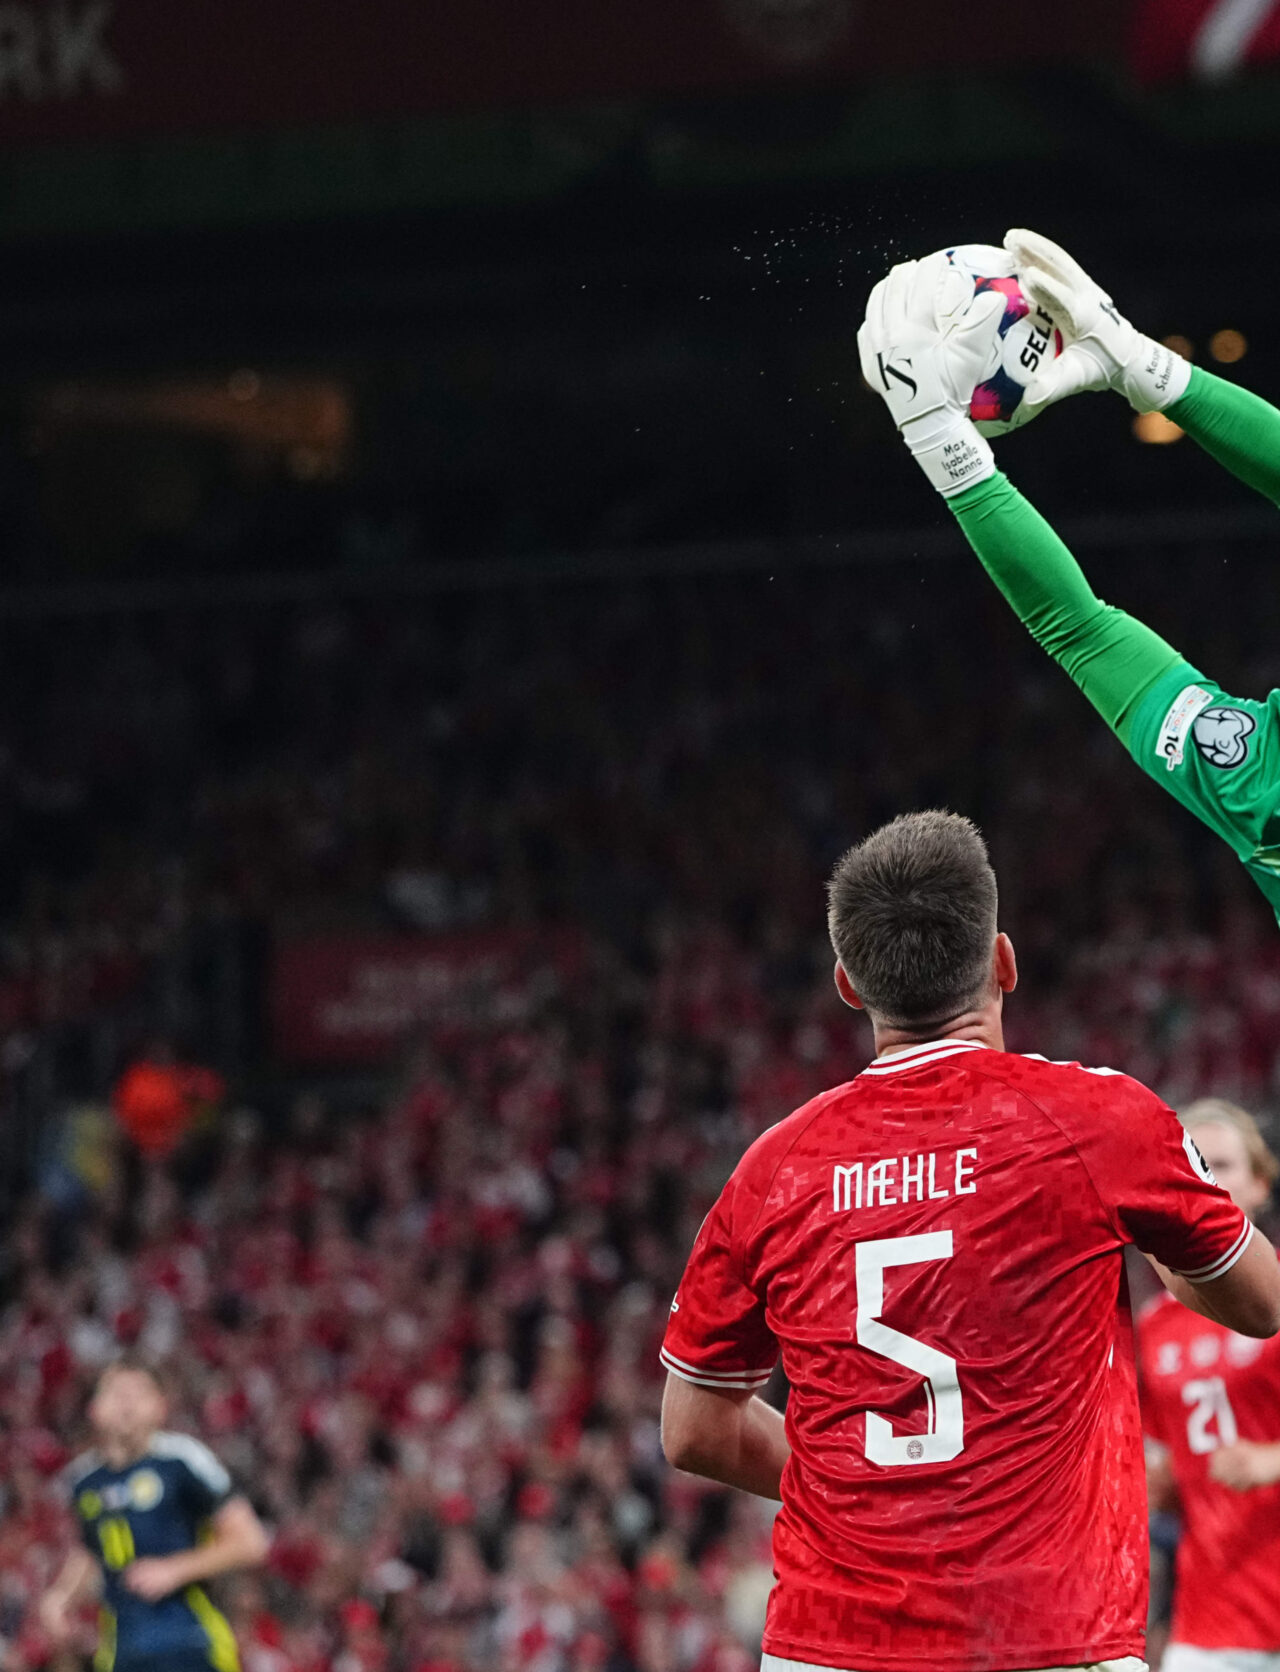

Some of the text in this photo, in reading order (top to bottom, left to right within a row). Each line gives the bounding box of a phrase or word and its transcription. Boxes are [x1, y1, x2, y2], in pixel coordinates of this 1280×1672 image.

[943, 440, 966, 457] Max
[949, 457, 983, 480] Nanna
[833, 1147, 978, 1212] MÆHLE
[855, 1229, 964, 1466] 5
[1181, 1376, 1239, 1455] 21
